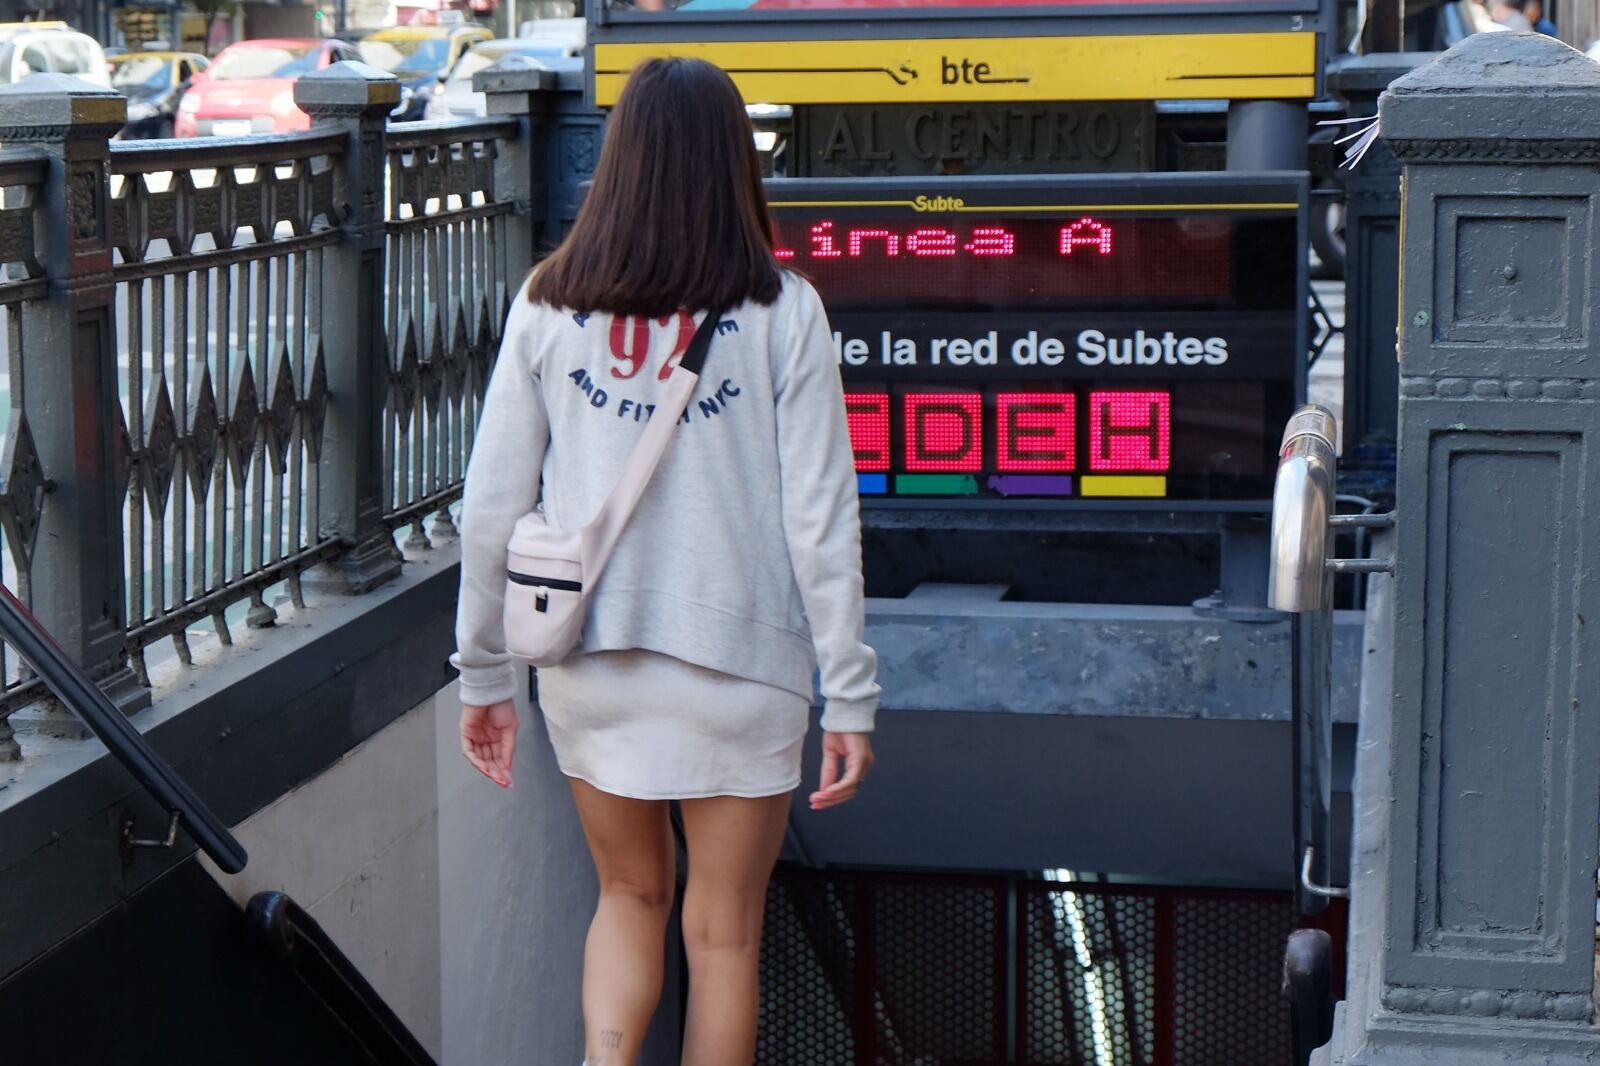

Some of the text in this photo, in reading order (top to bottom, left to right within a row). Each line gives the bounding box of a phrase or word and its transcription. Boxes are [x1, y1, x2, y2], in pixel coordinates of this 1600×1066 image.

[825, 107, 1121, 160] AL CENTRO
[913, 195, 965, 212] Subte
[774, 217, 1111, 256] inea A
[881, 331, 917, 366] la
[931, 331, 998, 366] red
[1011, 331, 1065, 366] de
[1077, 329, 1229, 367] Subtes
[568, 368, 608, 408] AND
[698, 379, 741, 419] NYC
[915, 404, 973, 462] D
[1008, 403, 1066, 462] E
[1100, 401, 1159, 462] H
